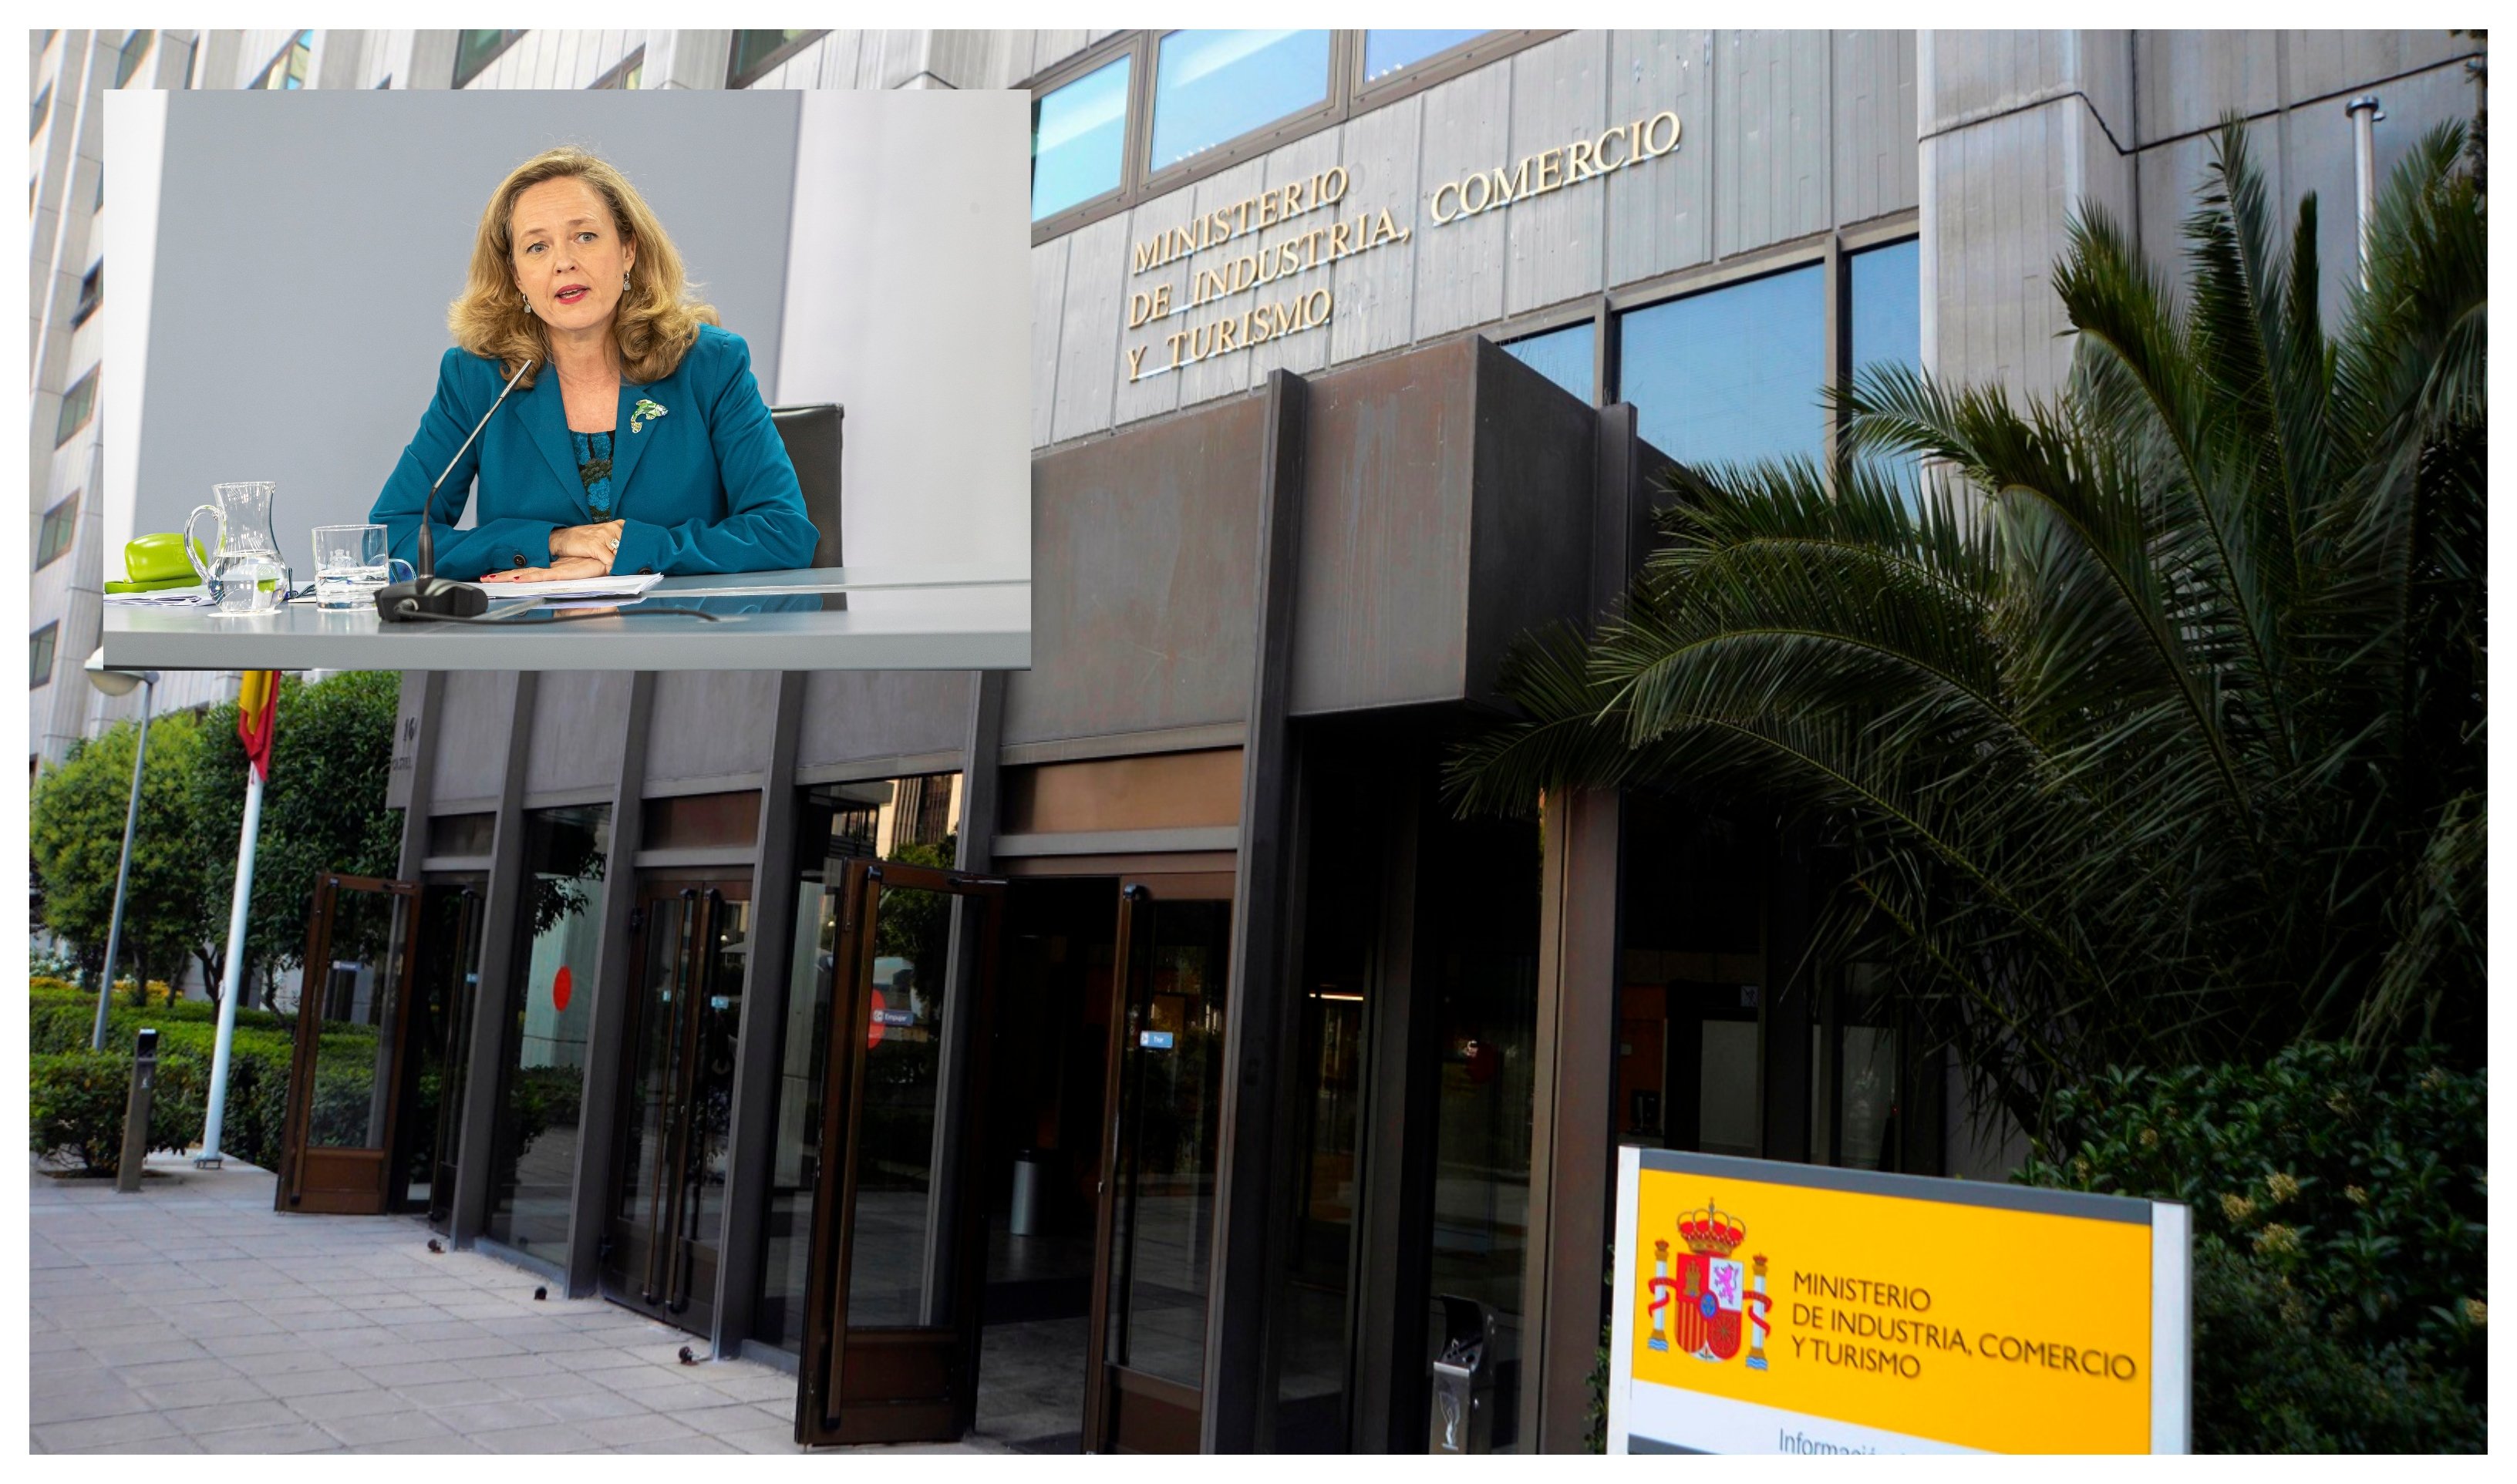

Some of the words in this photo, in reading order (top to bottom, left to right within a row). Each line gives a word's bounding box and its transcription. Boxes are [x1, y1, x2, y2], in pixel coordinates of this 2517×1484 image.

[1128, 283, 1172, 329] DE
[1193, 206, 1411, 306] INDUSTRIA,
[1431, 111, 1682, 224] COMERCIO
[1134, 166, 1348, 275] MINISTERIO
[1127, 345, 1147, 381] Y
[1167, 288, 1333, 368] TURISMO
[1794, 1270, 1931, 1312] MINISTERIO
[1791, 1334, 1806, 1359] Y
[1809, 1338, 1921, 1379] TURISMO
[1792, 1303, 1824, 1330] DE
[1831, 1308, 1973, 1357] INDUSTRIA,
[1978, 1332, 2137, 1381] COMERCIO
